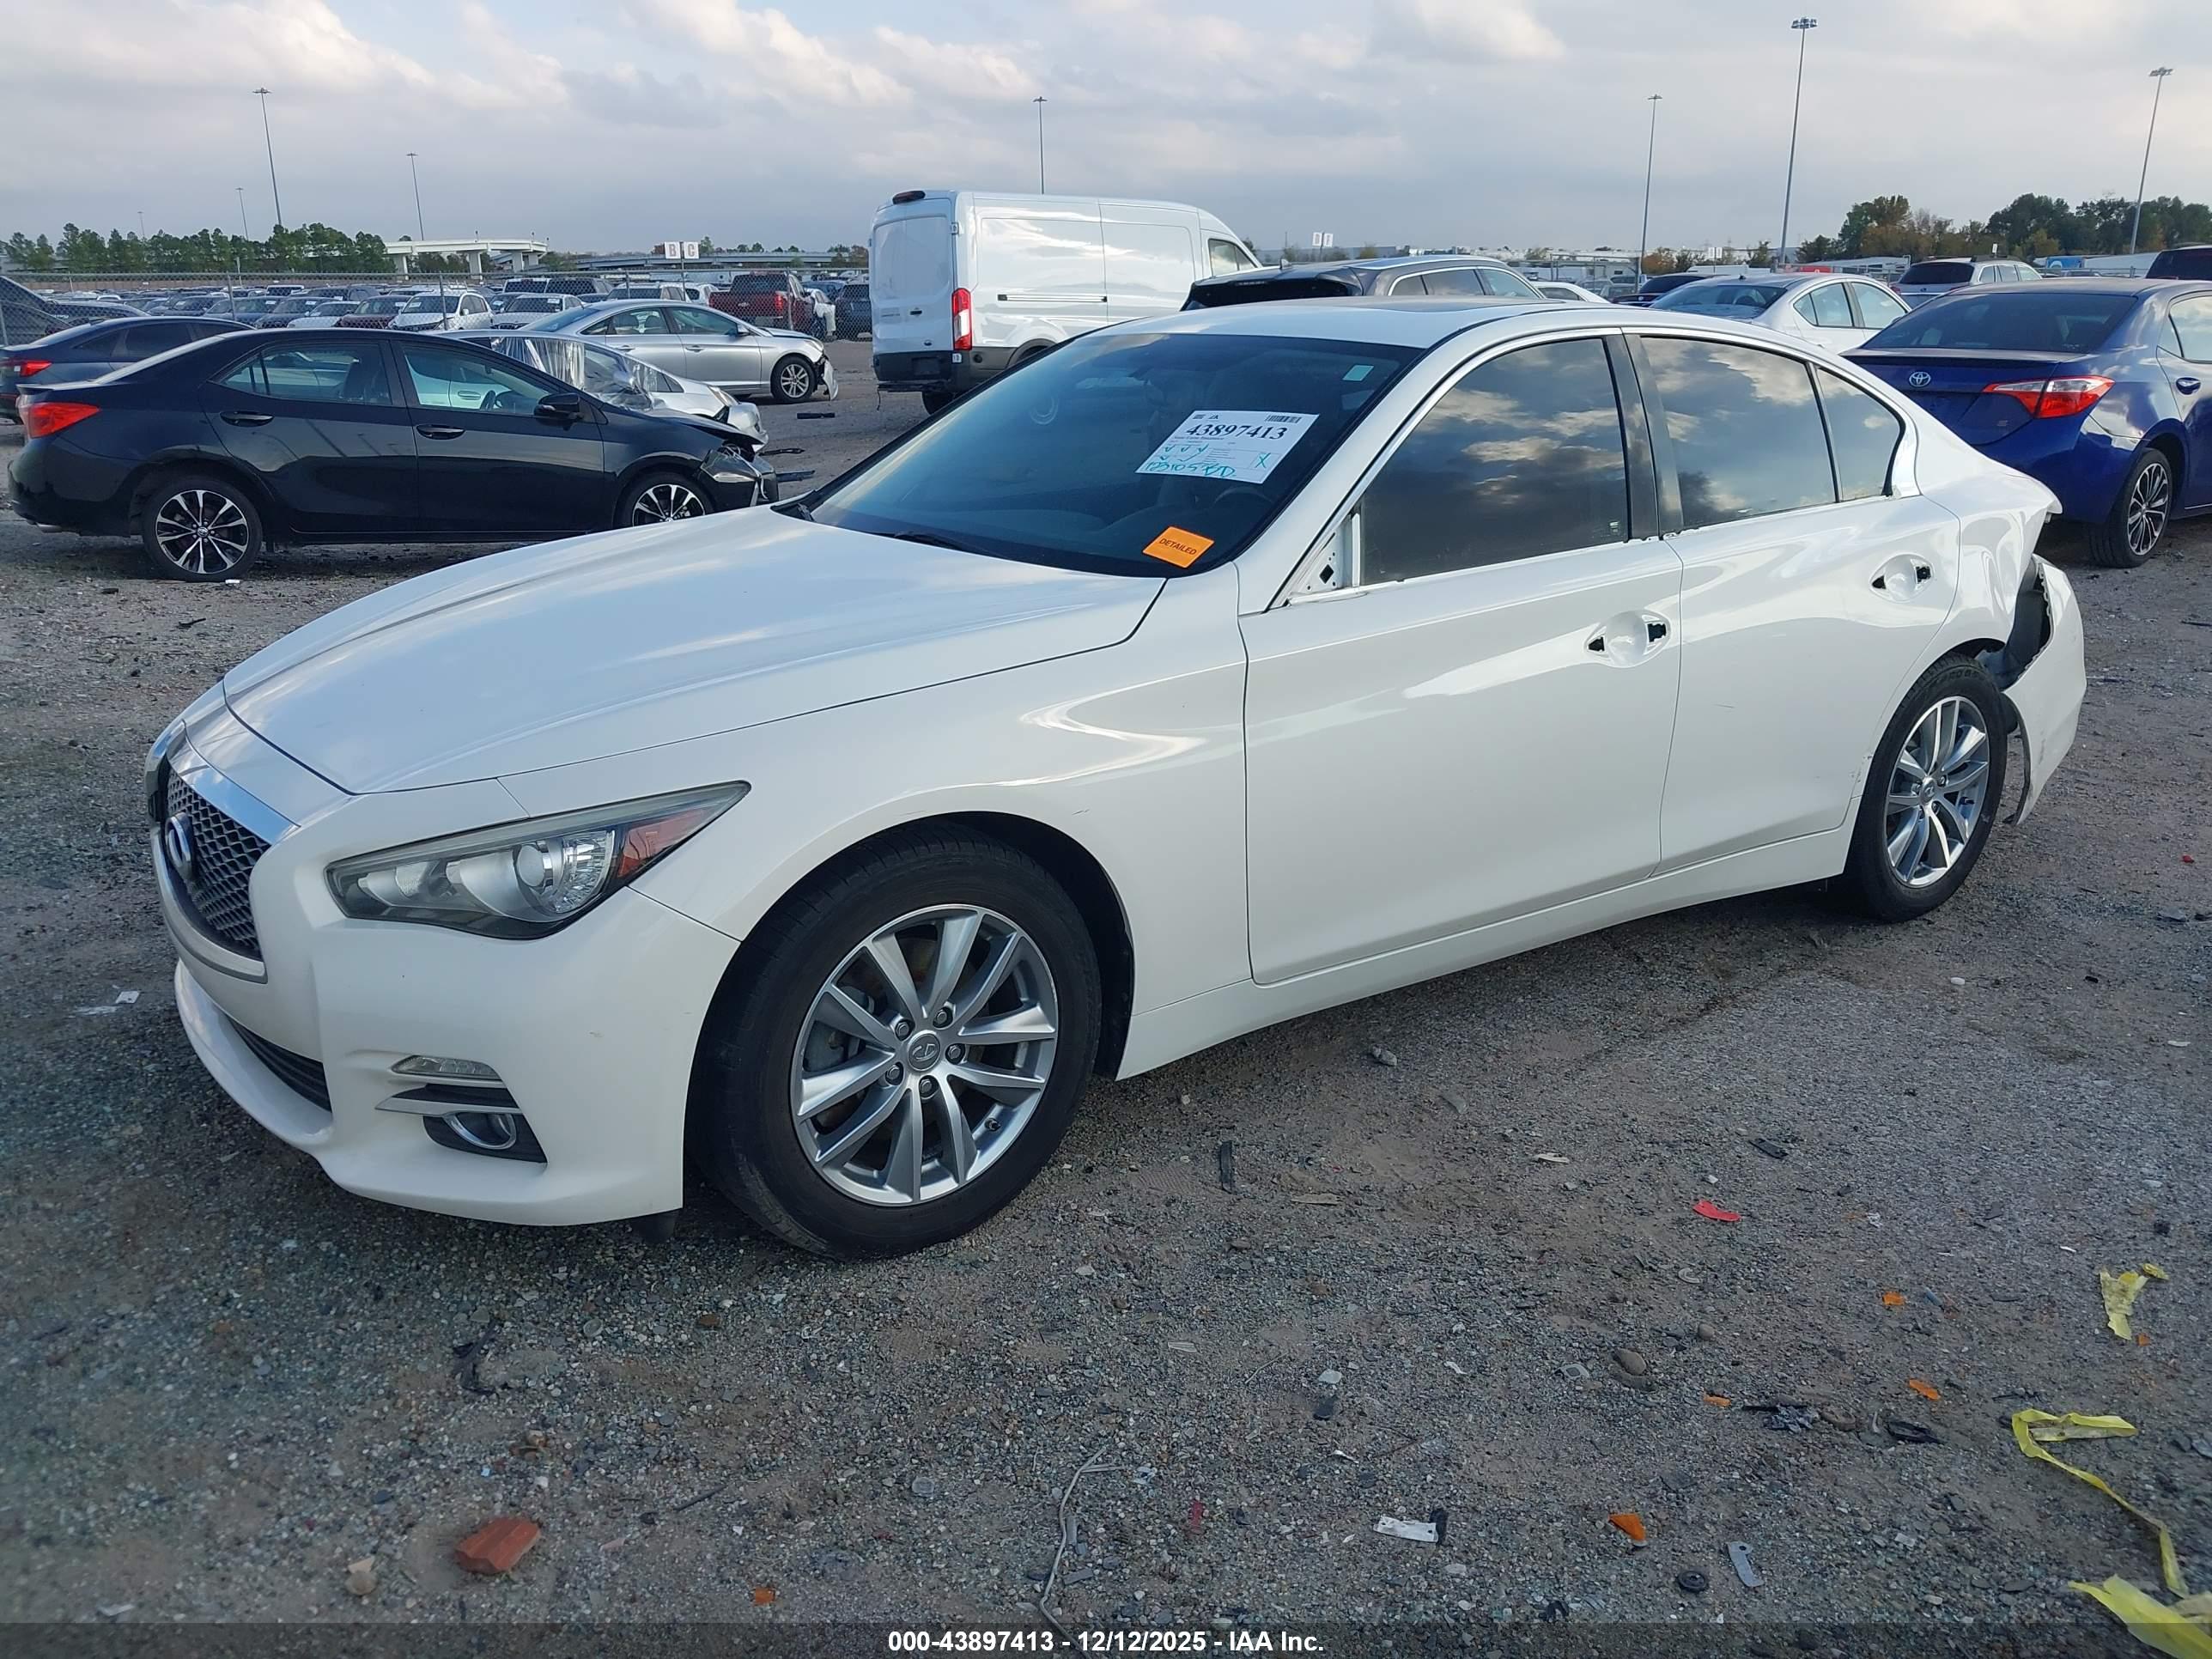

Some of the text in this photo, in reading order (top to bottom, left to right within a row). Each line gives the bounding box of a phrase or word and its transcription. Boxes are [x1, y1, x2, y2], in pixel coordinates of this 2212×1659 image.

[669, 244, 677, 257] B
[687, 244, 695, 257] C
[1186, 423, 1287, 439] 43897413
[1159, 538, 1197, 556] DETAILED
